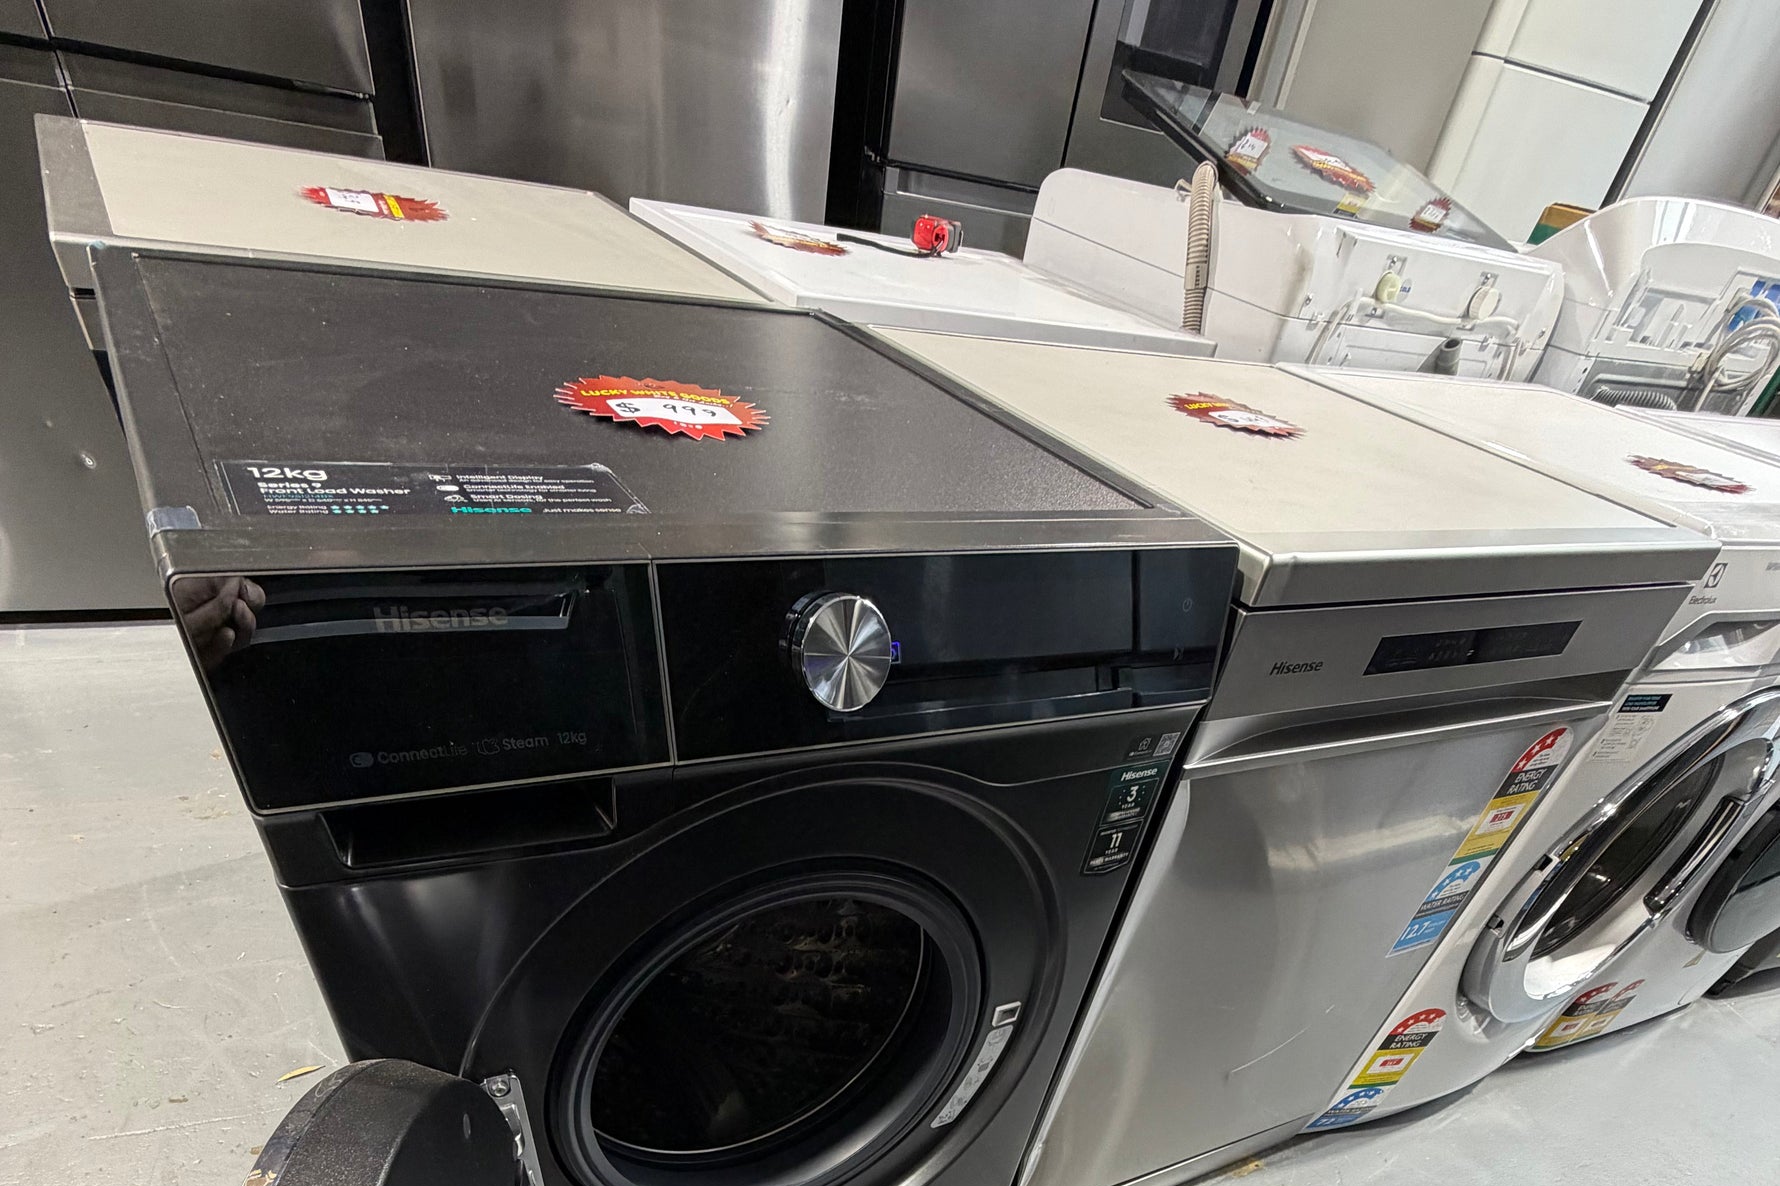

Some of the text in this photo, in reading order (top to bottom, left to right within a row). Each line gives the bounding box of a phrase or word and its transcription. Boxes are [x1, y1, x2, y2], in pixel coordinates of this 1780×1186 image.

[580, 389, 627, 397] LUCKY
[615, 402, 717, 417] $ 999
[247, 467, 328, 481] 12kg
[450, 506, 532, 514] Hisense
[373, 605, 508, 633] Hisense
[1269, 659, 1324, 676] Hisense
[502, 735, 549, 751] Steam
[557, 731, 587, 746] 12kg
[377, 744, 468, 764] ConnectLife
[1120, 767, 1158, 781] Hisense
[1514, 768, 1547, 783] ENERGY
[1126, 785, 1139, 802] 3
[1506, 780, 1538, 795] RATING
[1109, 832, 1123, 848] 11
[1389, 1041, 1422, 1049] RATING
[1394, 1033, 1428, 1042] ENERGY
